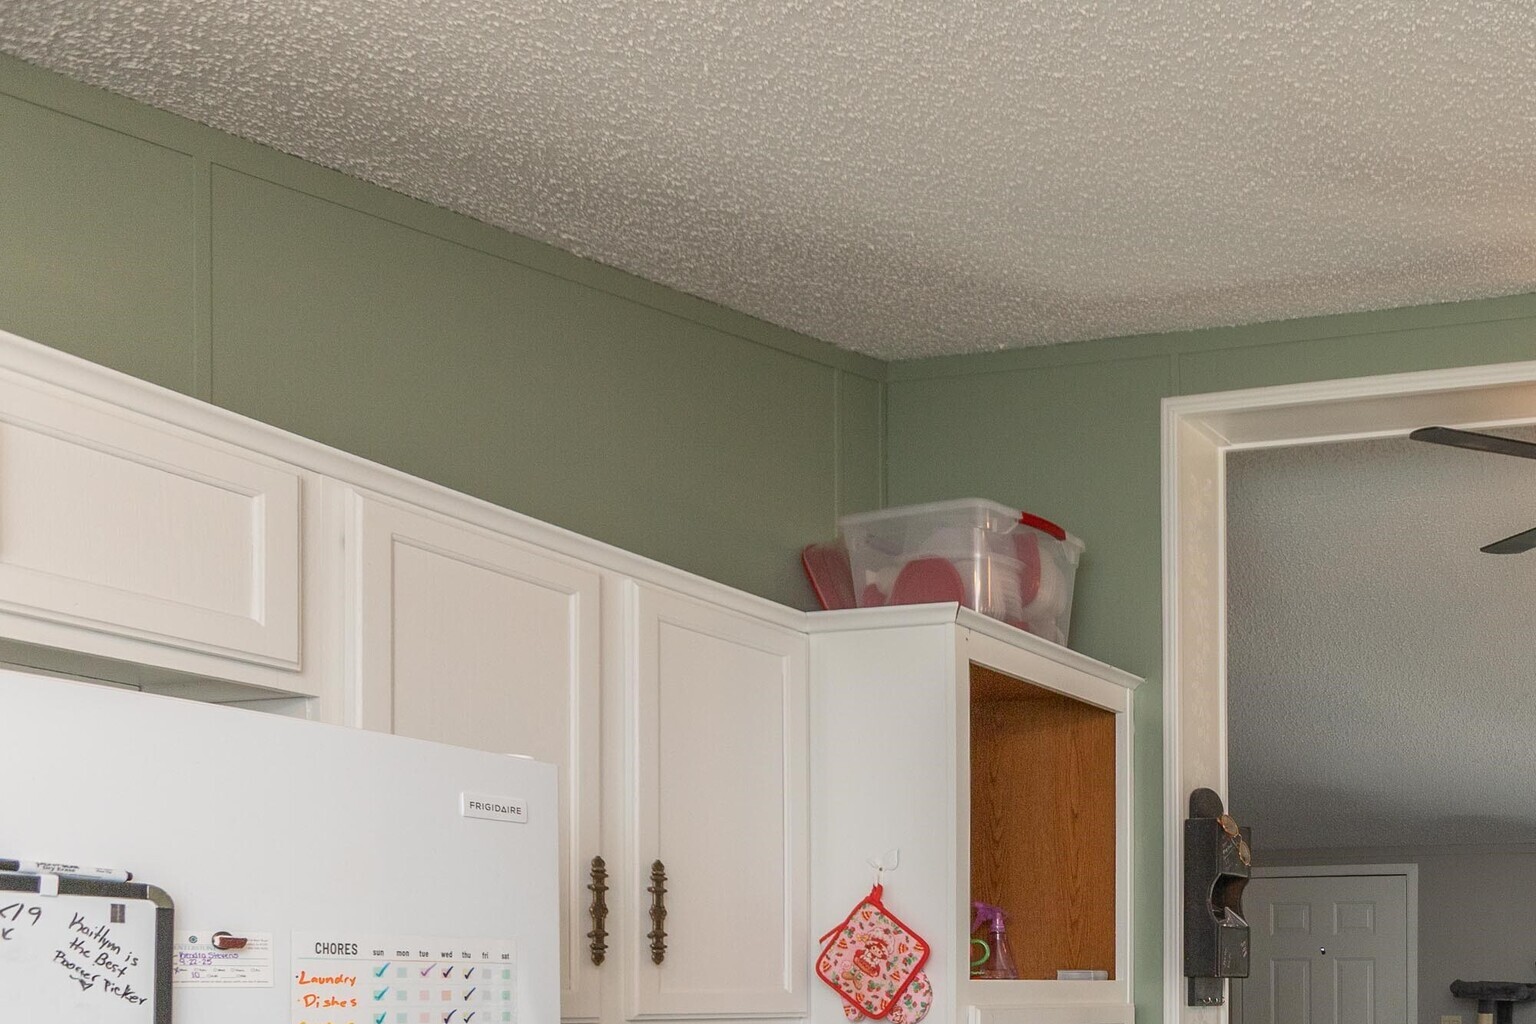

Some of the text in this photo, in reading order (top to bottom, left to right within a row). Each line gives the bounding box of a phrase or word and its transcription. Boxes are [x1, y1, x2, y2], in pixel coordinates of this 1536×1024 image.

[470, 801, 522, 814] FRIGIDAIRE
[69, 937, 90, 958] the
[315, 942, 358, 956] CHORES
[125, 952, 138, 966] is
[298, 970, 356, 986] Laundry
[303, 994, 357, 1008] Dishes
